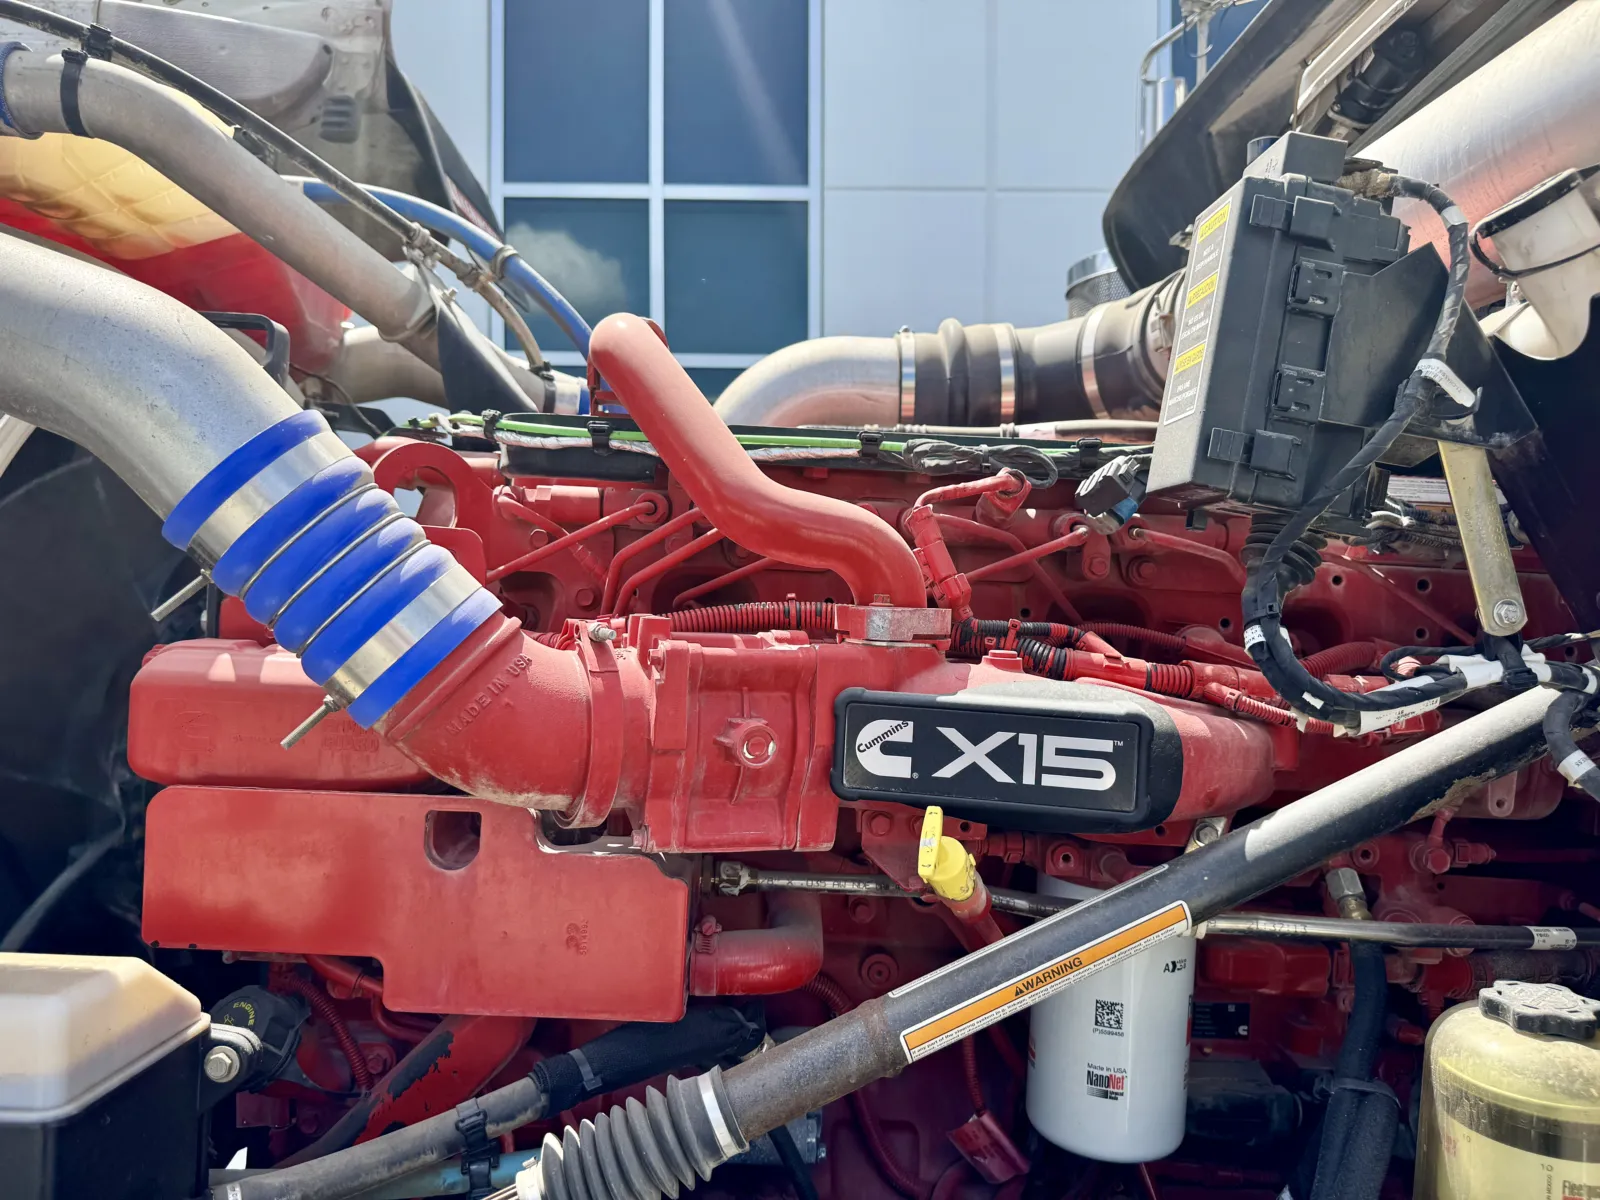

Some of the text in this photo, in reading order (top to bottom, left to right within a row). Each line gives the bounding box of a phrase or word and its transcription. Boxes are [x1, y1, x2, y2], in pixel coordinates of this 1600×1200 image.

[446, 653, 533, 736] MADE IN USA
[857, 720, 909, 754] Cummins
[931, 726, 1117, 791] X15
[1022, 957, 1083, 991] WARNING
[233, 1002, 256, 1026] ENGINE
[1087, 1063, 1104, 1071] Made
[1087, 1070, 1125, 1091] NanoNet
[1541, 1163, 1554, 1172] 10
